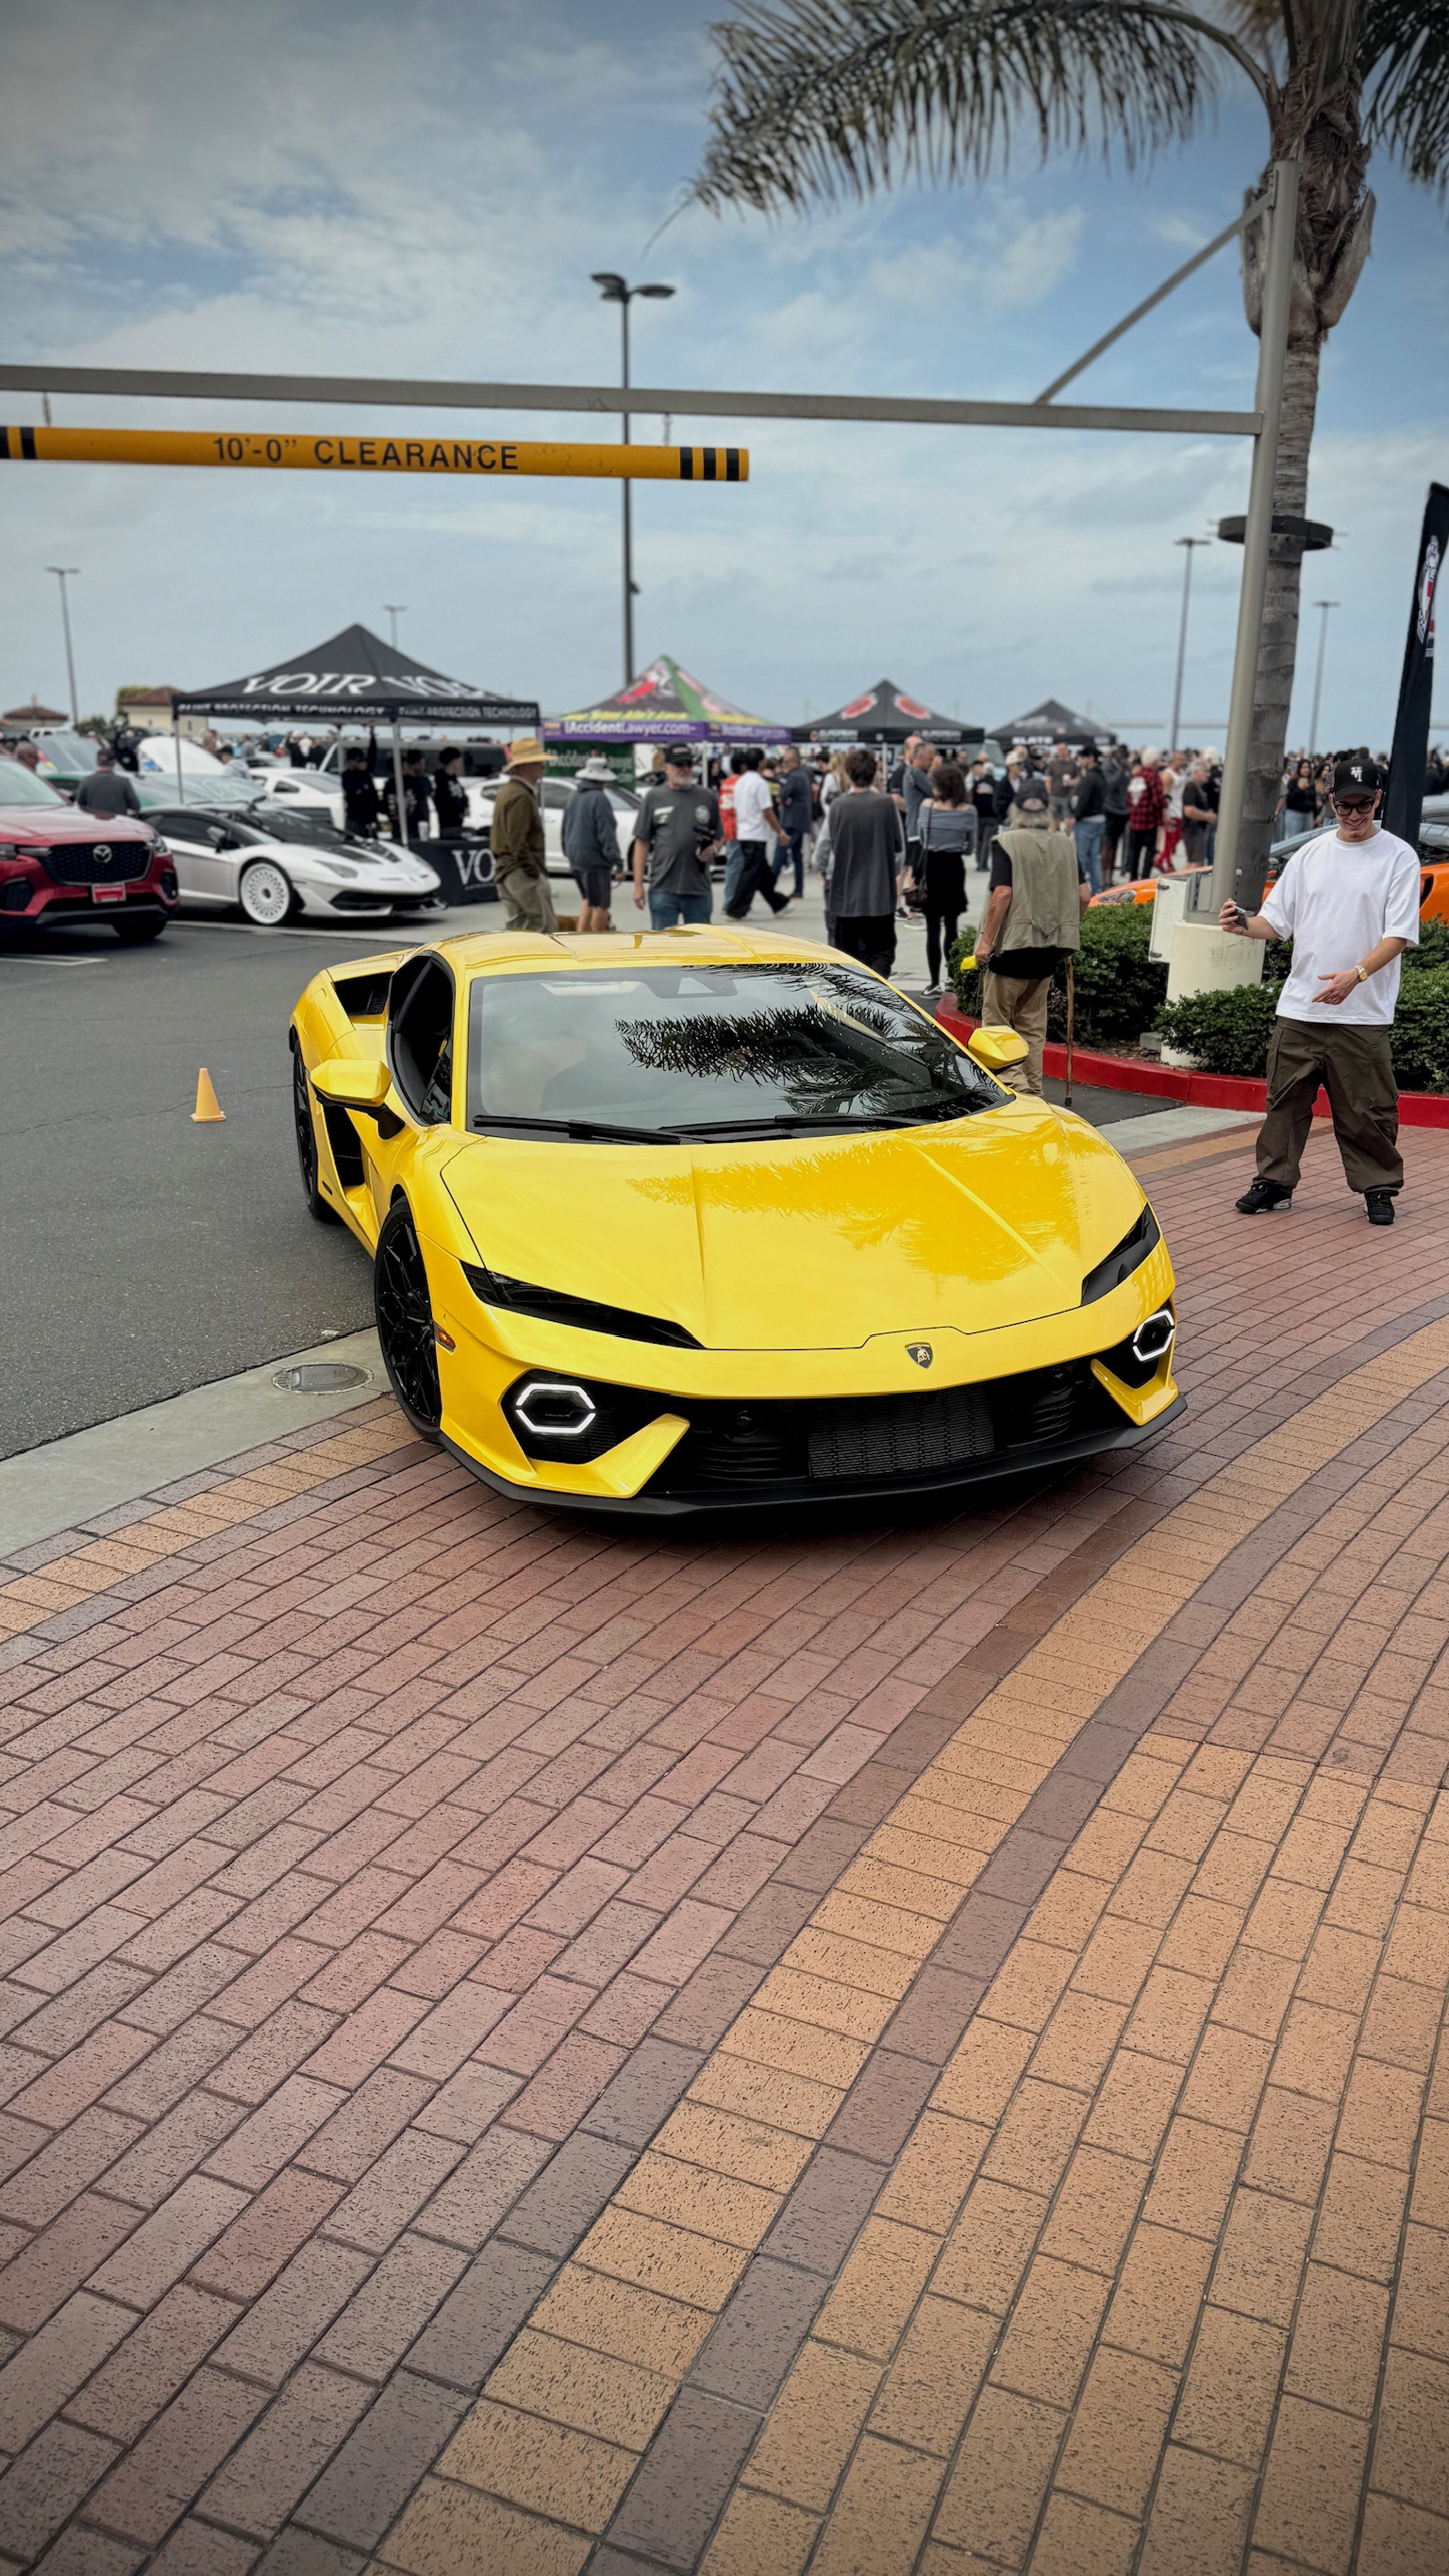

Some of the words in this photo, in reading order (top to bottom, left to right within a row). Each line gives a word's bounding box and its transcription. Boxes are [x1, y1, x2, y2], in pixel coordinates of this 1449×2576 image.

[314, 440, 518, 470] CLEARANCE
[242, 672, 377, 695] VOIR
[565, 721, 691, 736] iAccidentLawyer.com
